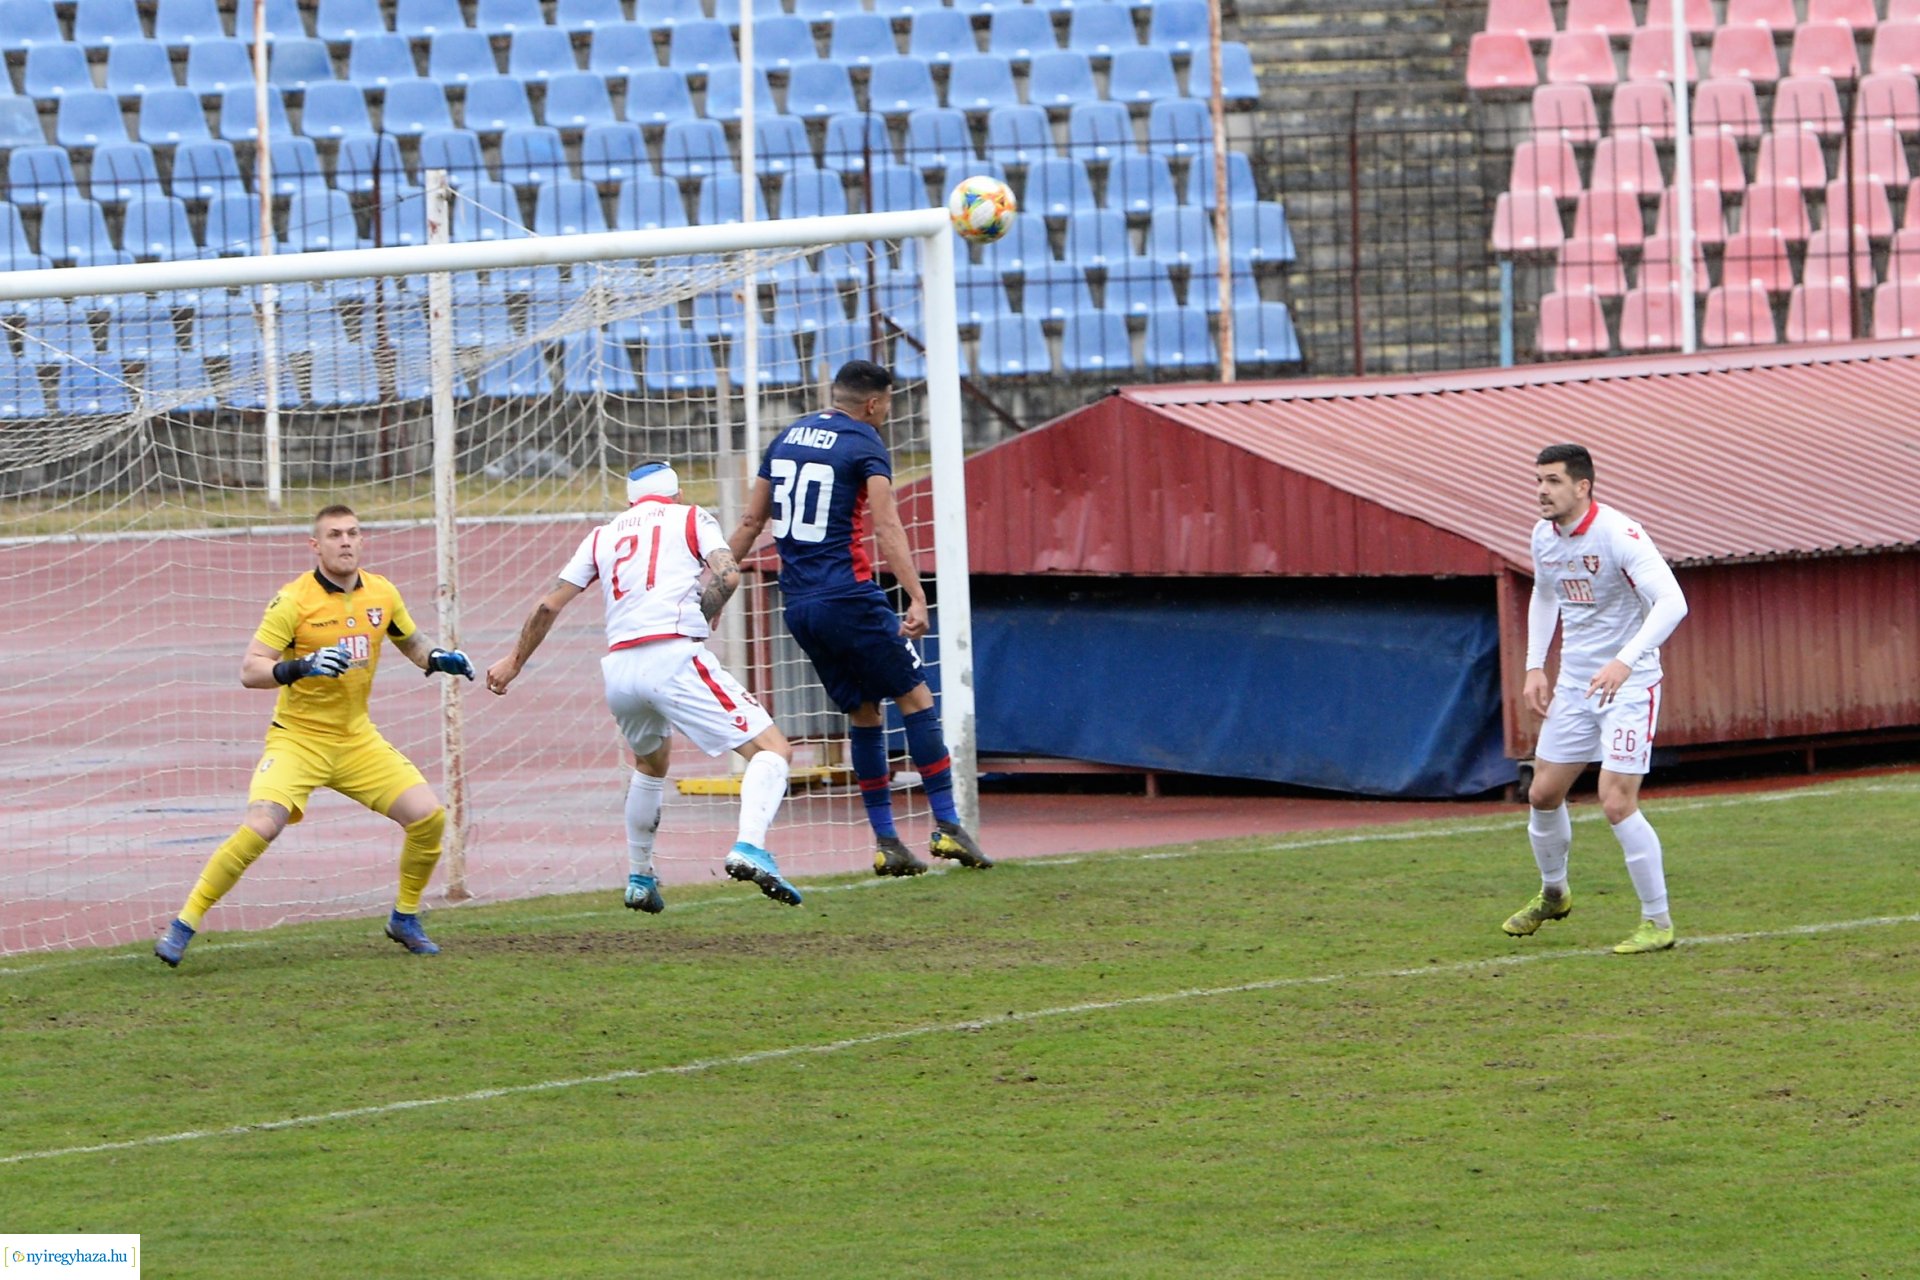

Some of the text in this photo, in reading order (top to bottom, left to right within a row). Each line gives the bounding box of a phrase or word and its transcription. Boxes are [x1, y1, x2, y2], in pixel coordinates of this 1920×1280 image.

[770, 459, 834, 542] 30
[612, 525, 660, 601] 21
[1564, 580, 1594, 601] HR
[1613, 728, 1636, 752] 26
